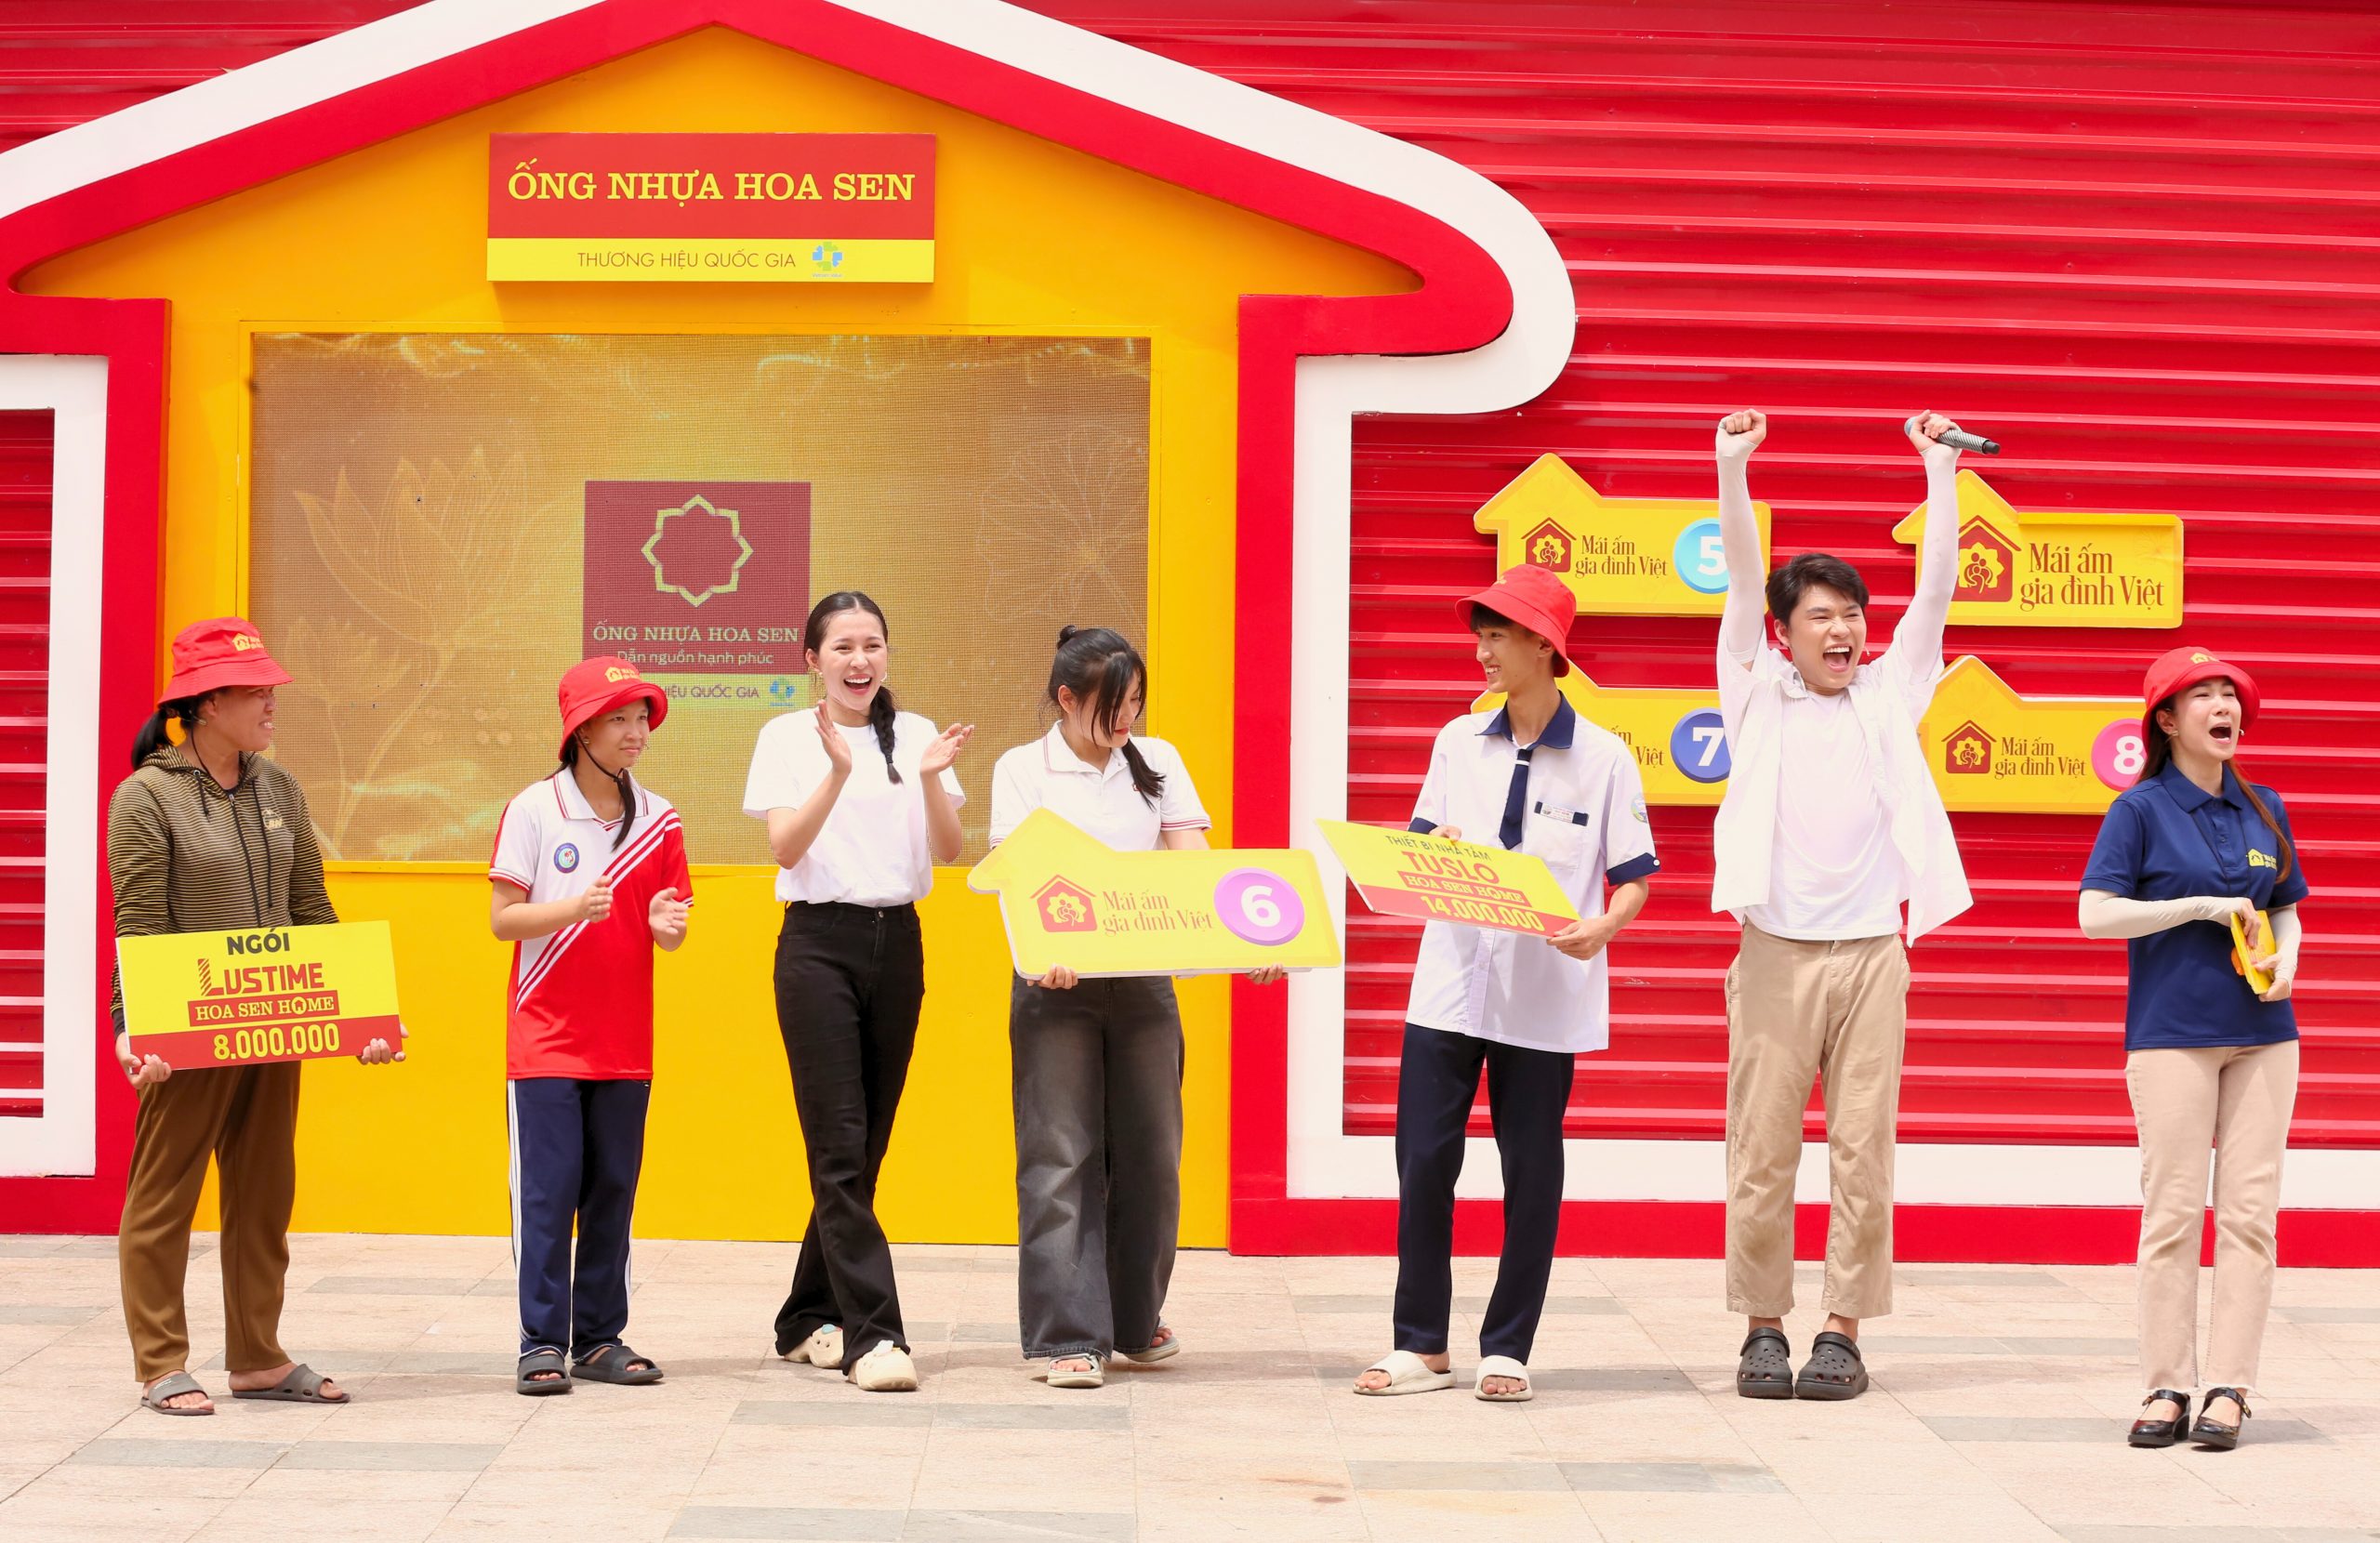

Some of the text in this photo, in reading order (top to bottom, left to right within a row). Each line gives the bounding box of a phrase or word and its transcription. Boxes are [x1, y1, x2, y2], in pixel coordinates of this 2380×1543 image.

[508, 158, 915, 207] ỐNG NHỰA HOA SEN
[577, 248, 797, 270] THƯƠNG HIỆU QUỐC GIA
[1581, 534, 1635, 556] Mái ấm
[1697, 536, 1727, 576] 5
[2029, 543, 2113, 574] Mái ấm
[1575, 556, 1668, 579] gia đình Việt
[2019, 574, 2164, 613] gia đình Việt
[593, 620, 799, 646] ỐNG NHỰA HOA SEN
[617, 648, 774, 666] Dẫn nguồn hạnh phúc
[664, 683, 760, 699] IỆU QUỐC GIA
[1635, 745, 1664, 769] Việt
[1692, 727, 1725, 767] 7
[2001, 736, 2055, 757] Mái ấm
[2113, 735, 2145, 775] 8
[1994, 757, 2086, 780] gia đình Việt
[1402, 851, 1500, 884] TUSLO
[1103, 889, 1170, 911] Mái ấm
[1404, 875, 1526, 903] HOA SEN HOME
[1239, 885, 1281, 928] 6
[1421, 895, 1546, 931] 14.000.000
[1103, 914, 1130, 937] gia
[1176, 909, 1212, 932] Việt
[226, 929, 290, 956] NGÓI
[195, 996, 335, 1021] HOA SEN HOME
[213, 1022, 340, 1061] 8.000.000
